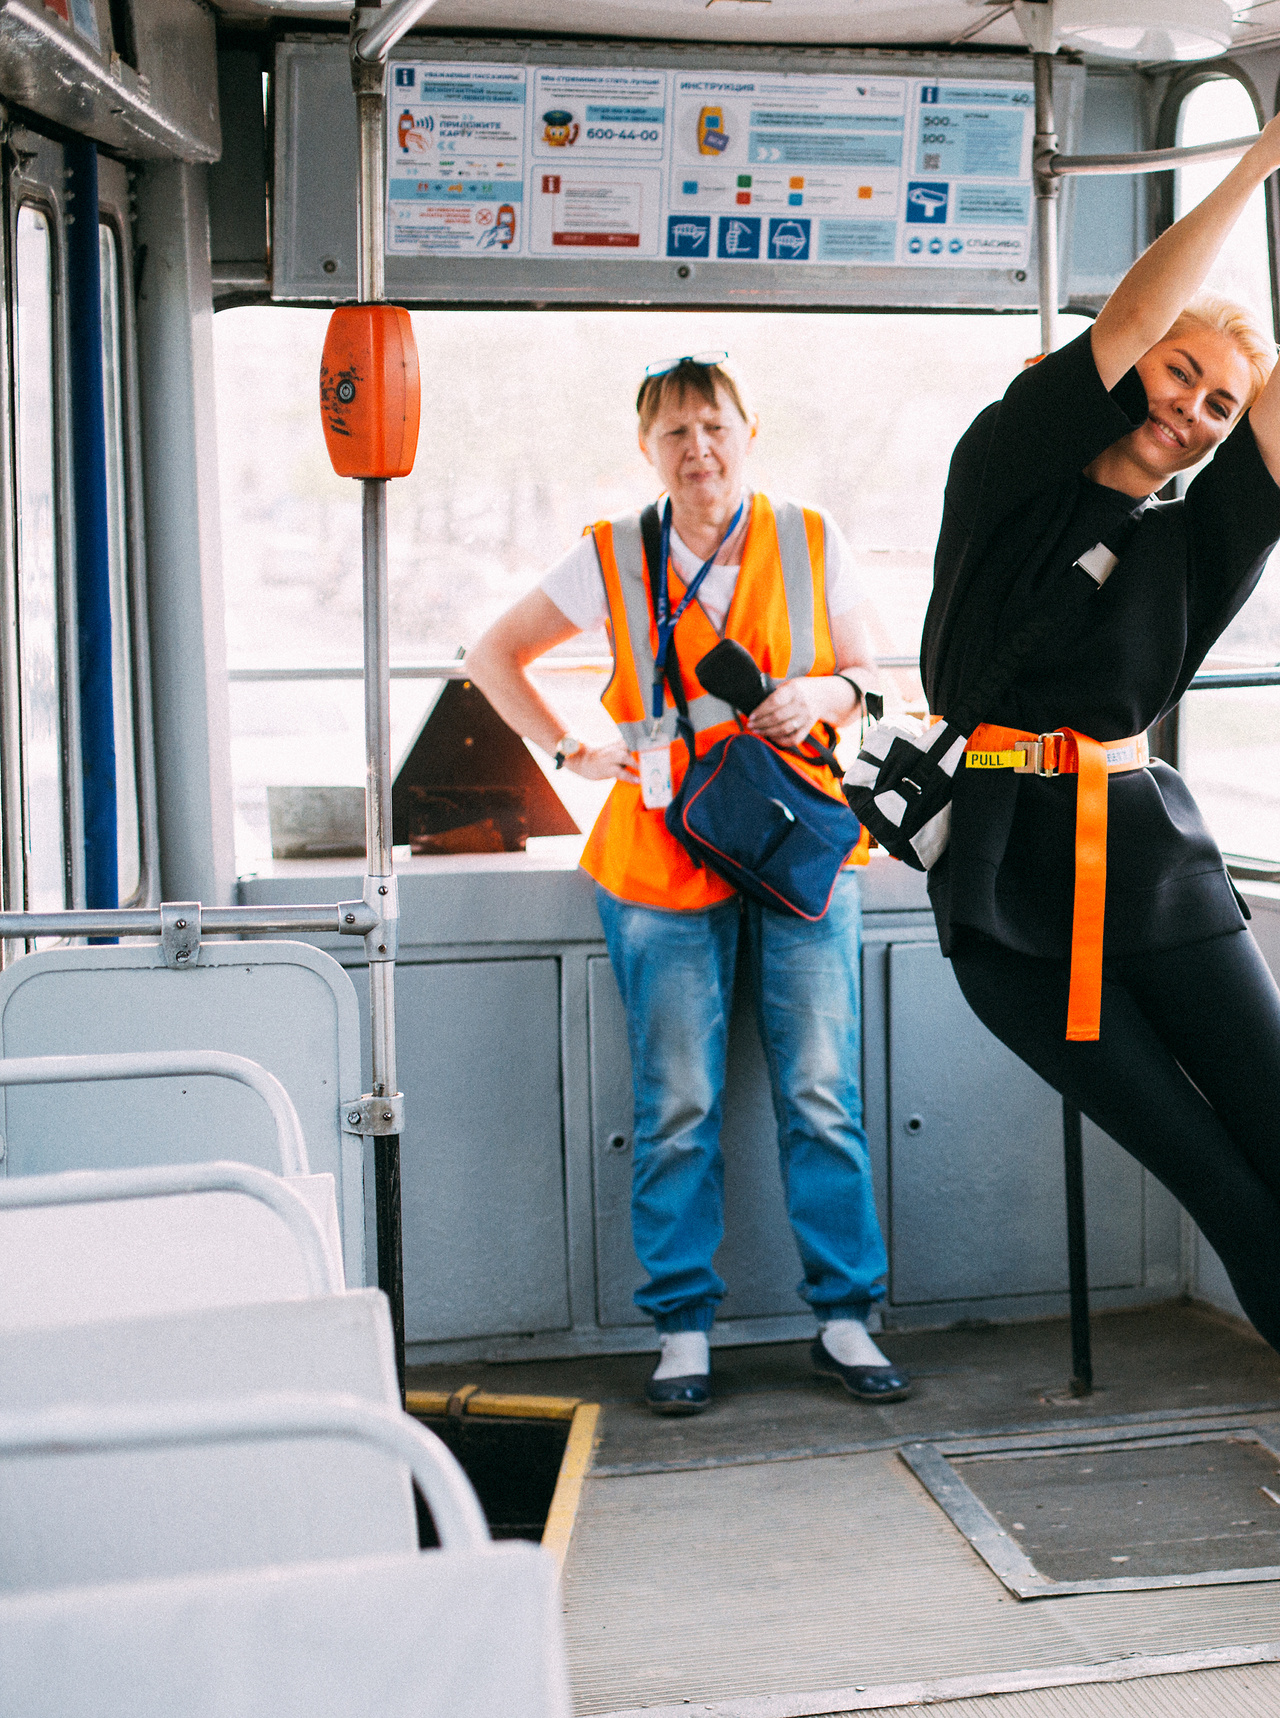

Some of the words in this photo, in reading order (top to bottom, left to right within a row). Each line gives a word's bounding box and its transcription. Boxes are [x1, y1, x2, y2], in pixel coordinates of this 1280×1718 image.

[680, 81, 755, 92] ИНСТРУКЦИЯ
[440, 121, 501, 129] ПРИЛОЖИТЕ
[924, 115, 950, 126] 500
[586, 128, 659, 141] 600-44-00
[971, 755, 1004, 766] PULL
